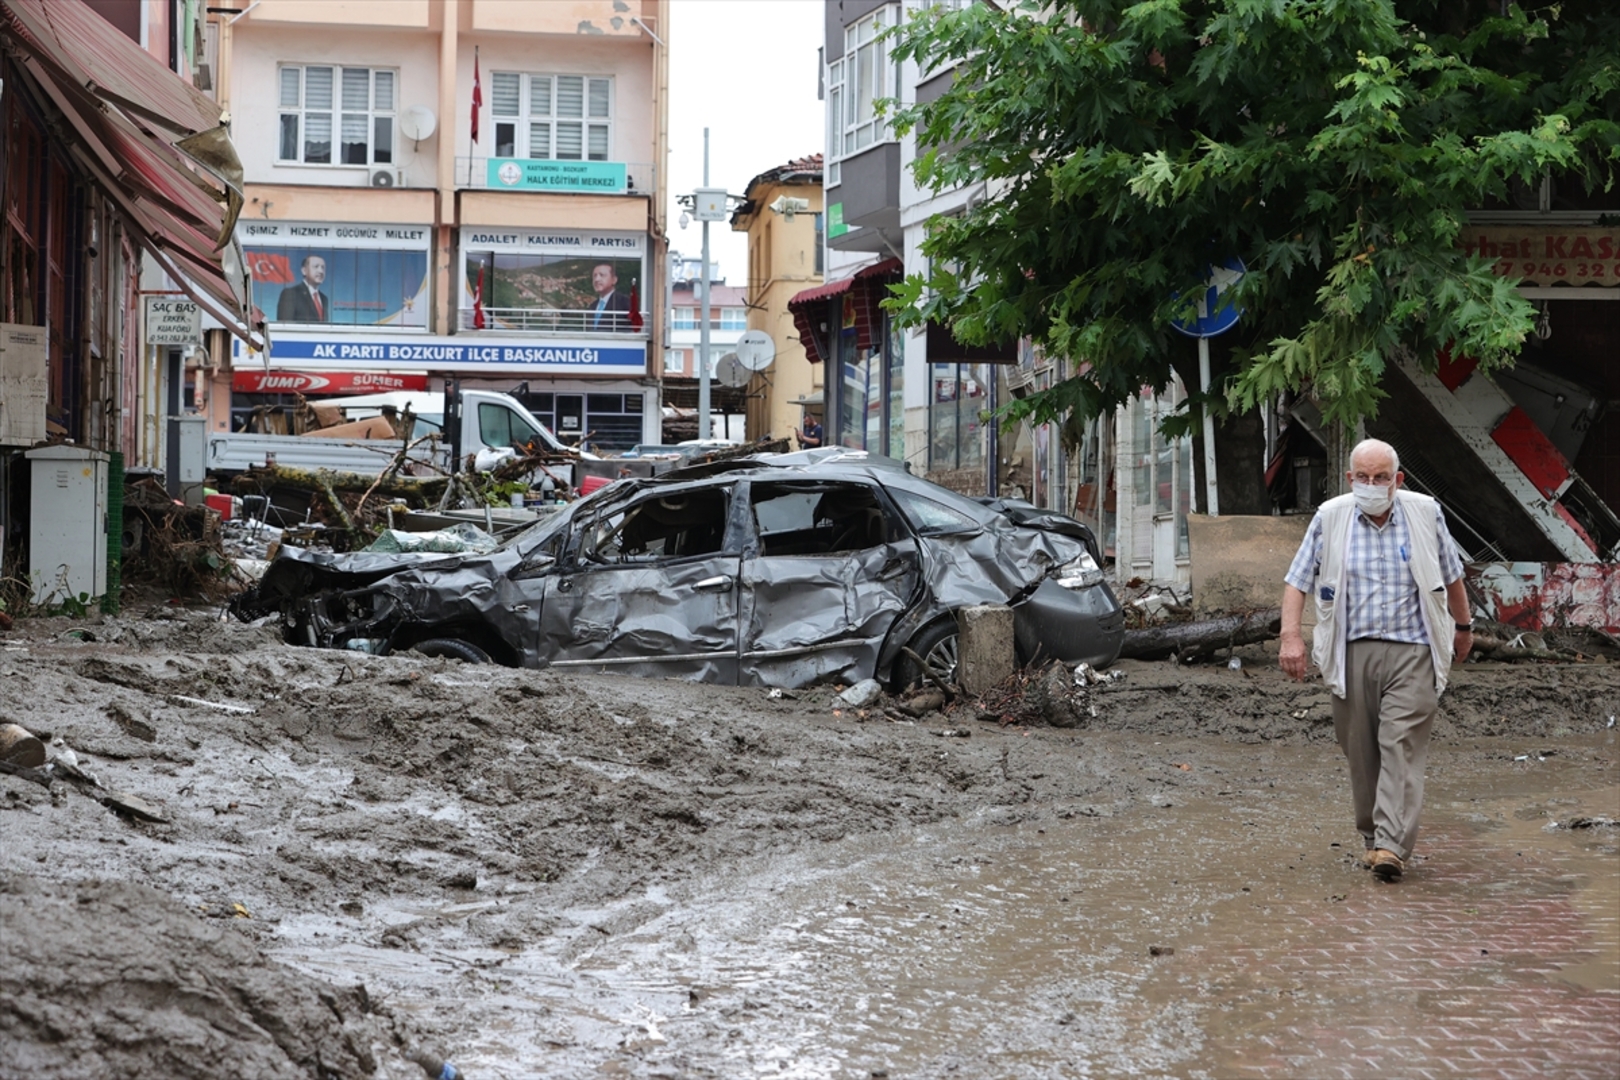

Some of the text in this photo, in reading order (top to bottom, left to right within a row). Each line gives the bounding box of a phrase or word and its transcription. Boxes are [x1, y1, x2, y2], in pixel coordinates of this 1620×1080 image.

[527, 175, 615, 187] HALK EĞİTİMİ MERKEZİ
[290, 227, 330, 237] HİZMET
[336, 228, 378, 238] GÜCÜMÜZ
[385, 230, 424, 240] MİLLET
[471, 234, 636, 248] ADALET KALKINMA PARTİSİ
[1456, 236, 1620, 260] rhat KAS
[1523, 262, 1567, 277] 946
[1576, 263, 1605, 278] 32
[152, 303, 197, 315] SAÇ BAŞ
[162, 315, 186, 323] ERKEK
[312, 344, 599, 363] AK PARTİ BOZKURT İLÇE BAŞKANLIĞI
[256, 373, 404, 390] JUMP SÜMER
